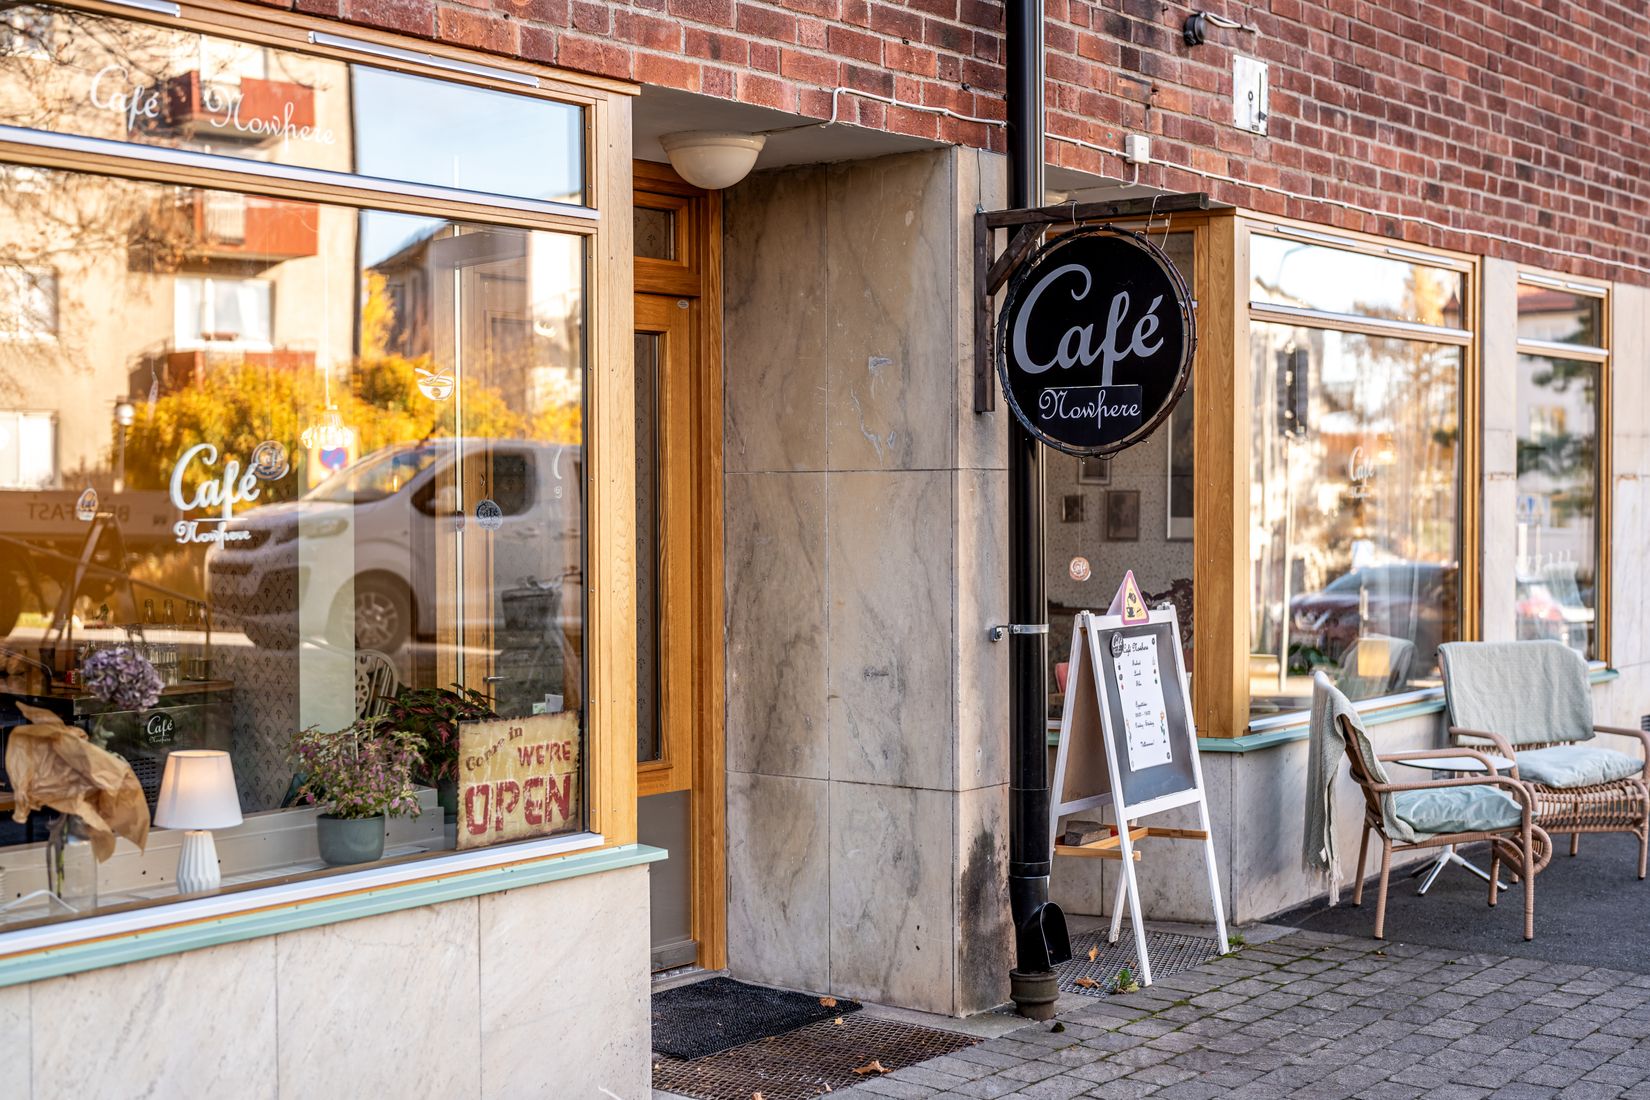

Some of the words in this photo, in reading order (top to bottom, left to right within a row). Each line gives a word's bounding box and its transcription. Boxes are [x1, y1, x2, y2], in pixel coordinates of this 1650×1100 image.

[90, 64, 159, 131] Café
[203, 86, 336, 151] Nowhere
[1013, 263, 1164, 386] Café
[1038, 389, 1141, 430] Nowhere
[169, 443, 261, 519] Café
[147, 715, 174, 736] Café
[465, 737, 505, 771] Come
[508, 726, 523, 741] in
[464, 774, 571, 835] OPEN
